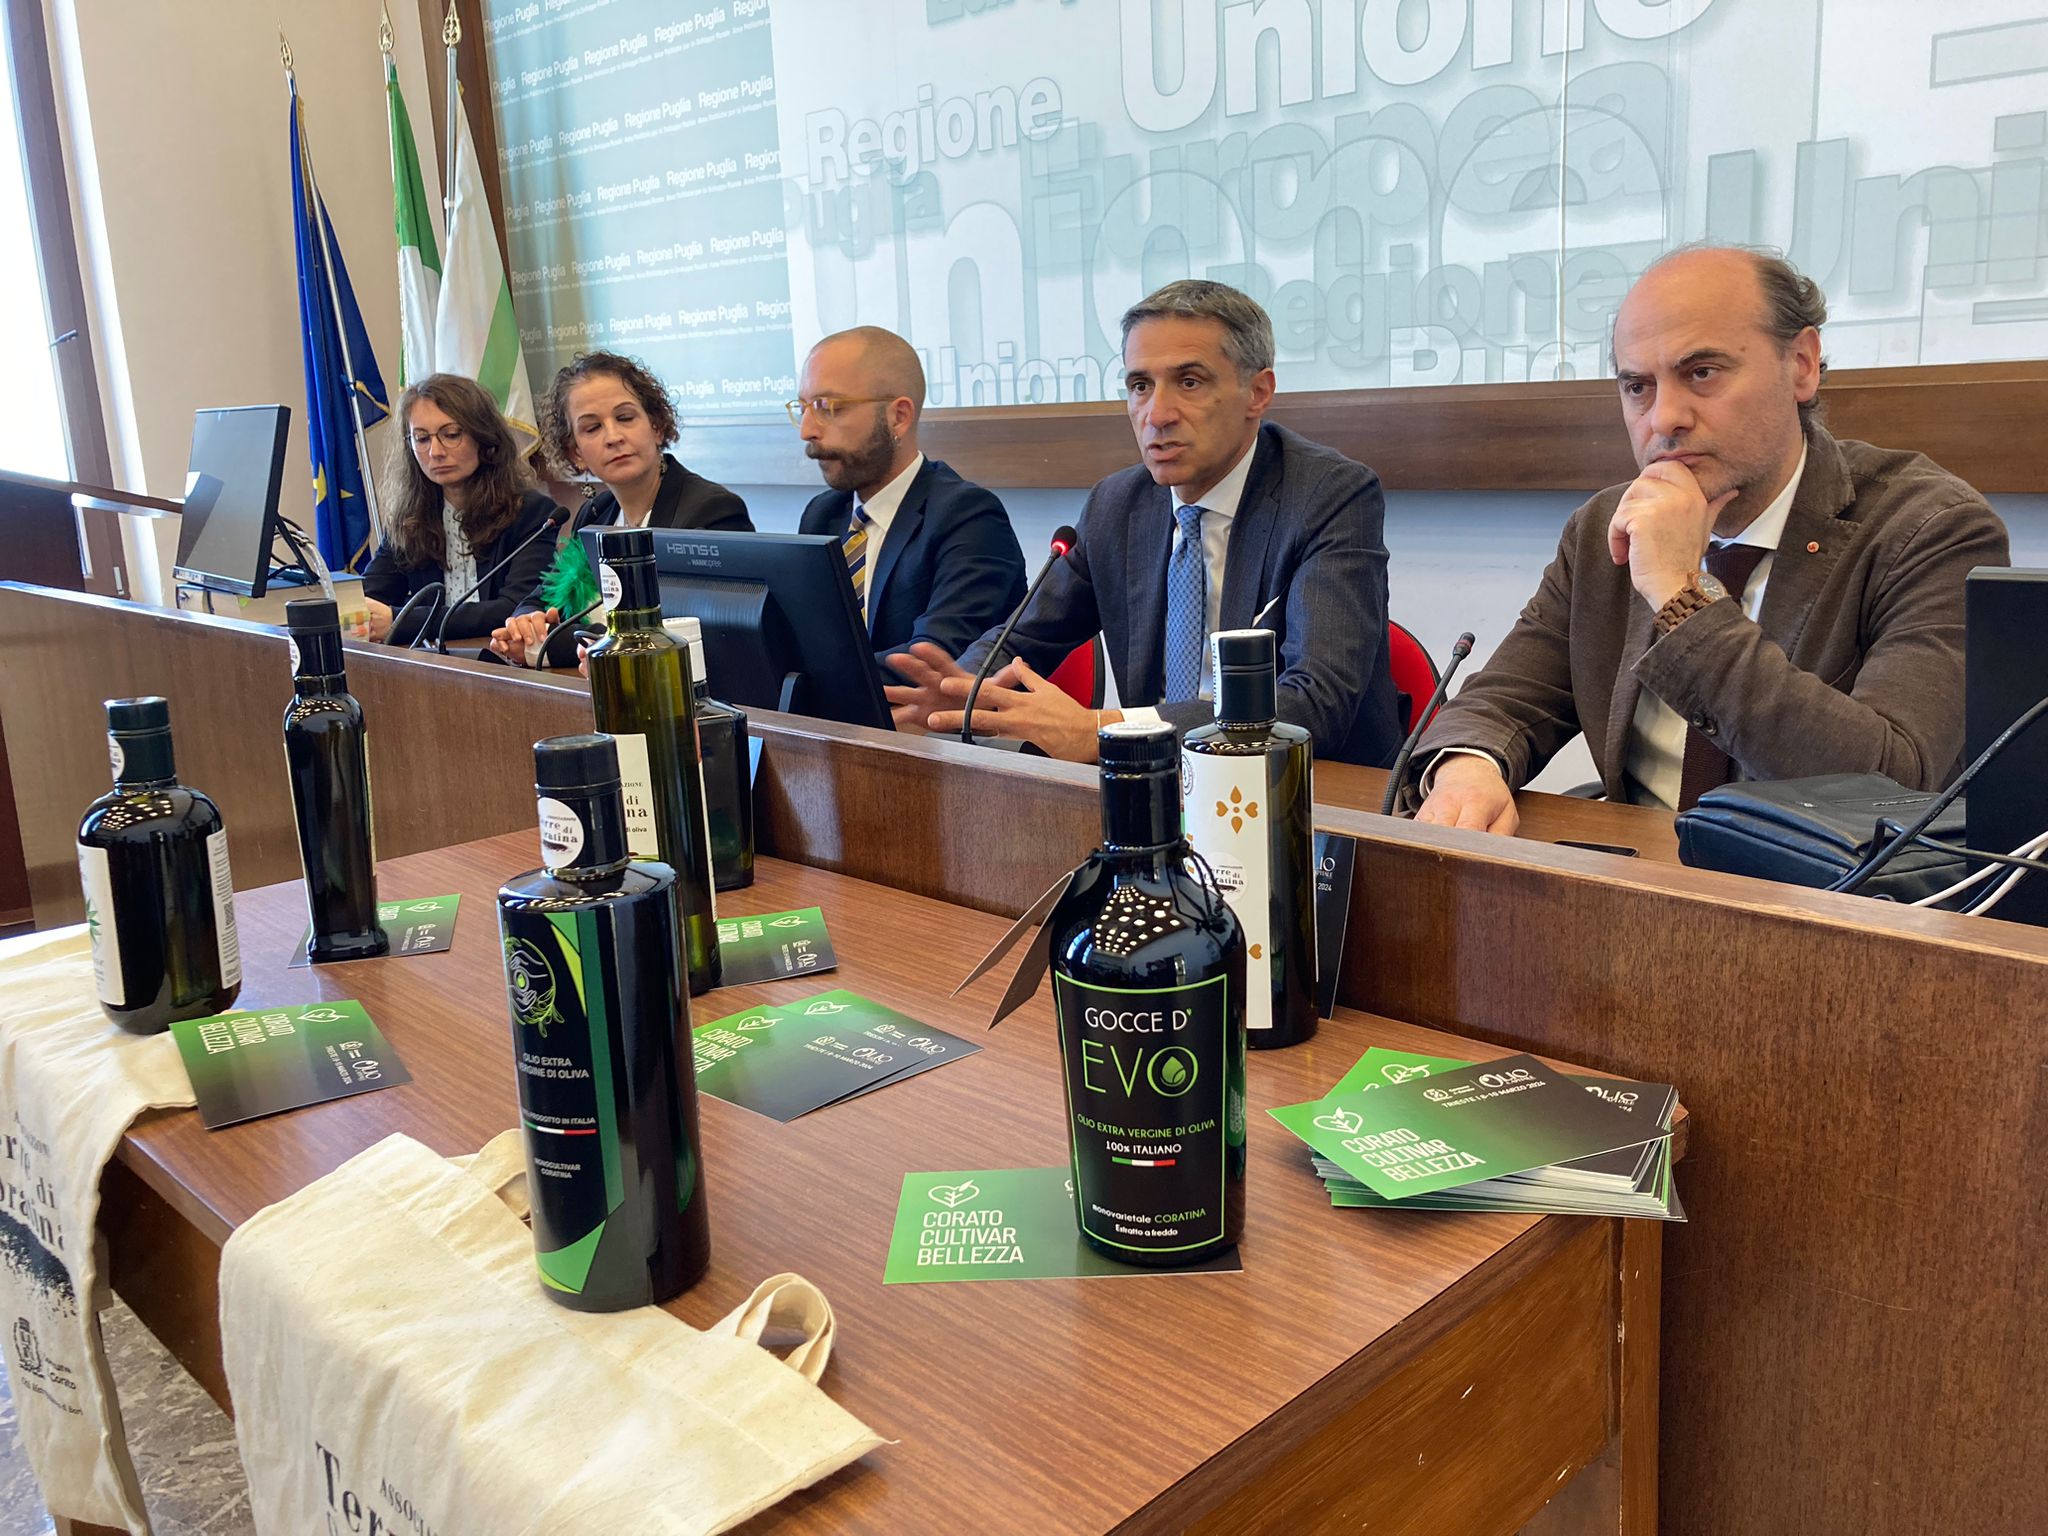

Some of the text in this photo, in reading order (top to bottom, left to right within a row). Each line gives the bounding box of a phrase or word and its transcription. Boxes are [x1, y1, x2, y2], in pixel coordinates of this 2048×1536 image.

[515, 3, 539, 22] Puglia
[654, 7, 726, 43] Regione Puglia
[584, 44, 619, 66] Regione
[619, 33, 648, 55] Puglia
[521, 65, 552, 86] Regione
[553, 55, 578, 76] Puglia
[699, 75, 773, 108] Regione Puglia
[624, 108, 661, 128] Regione
[662, 97, 692, 118] Puglia
[559, 126, 591, 146] Regione
[592, 118, 618, 137] Puglia
[805, 77, 1063, 187] Regione
[530, 135, 553, 154] Puglia
[667, 157, 737, 187] Regione Puglia
[566, 189, 592, 208] Puglia
[597, 182, 632, 202] Regione
[633, 174, 660, 194] Puglia
[710, 227, 784, 255] Regione Puglia
[572, 252, 631, 277] Regione Puglia
[637, 240, 703, 267] Regione Puglia
[542, 263, 566, 281] Puglia
[609, 312, 672, 334] Regione Puglia
[678, 304, 749, 327] Regione Puglia
[686, 380, 715, 398] Puglia
[722, 375, 795, 397] Regione Puglia
[626, 795, 639, 805] di
[1085, 1007, 1163, 1033] GOCCE
[198, 1022, 236, 1055] BELLEZZA
[701, 1028, 753, 1049] CORATO
[523, 1052, 572, 1067] OLIO EXTRA
[1082, 1039, 1199, 1098] EVO
[547, 1069, 556, 1078] DI
[558, 1069, 590, 1079] OLIVA
[1441, 1096, 1477, 1108] TRIESTE
[571, 1117, 596, 1125] ITALIA
[1077, 1113, 1215, 1138] OLIO EXTRA VERGINE DI OLIVA
[1133, 1143, 1182, 1155] ITALIANO
[1341, 1128, 1420, 1153] CORATO
[1361, 1139, 1456, 1168] CULTIVAR
[1381, 1151, 1487, 1182] BELLEZZA
[923, 1209, 1003, 1229] CORATO
[1092, 1203, 1206, 1224] monovarietale CORATINA
[920, 1227, 1016, 1246] CULTIVAR
[1115, 1224, 1178, 1237] Estratto a freddo
[916, 1246, 1024, 1266] BELLEZZA
